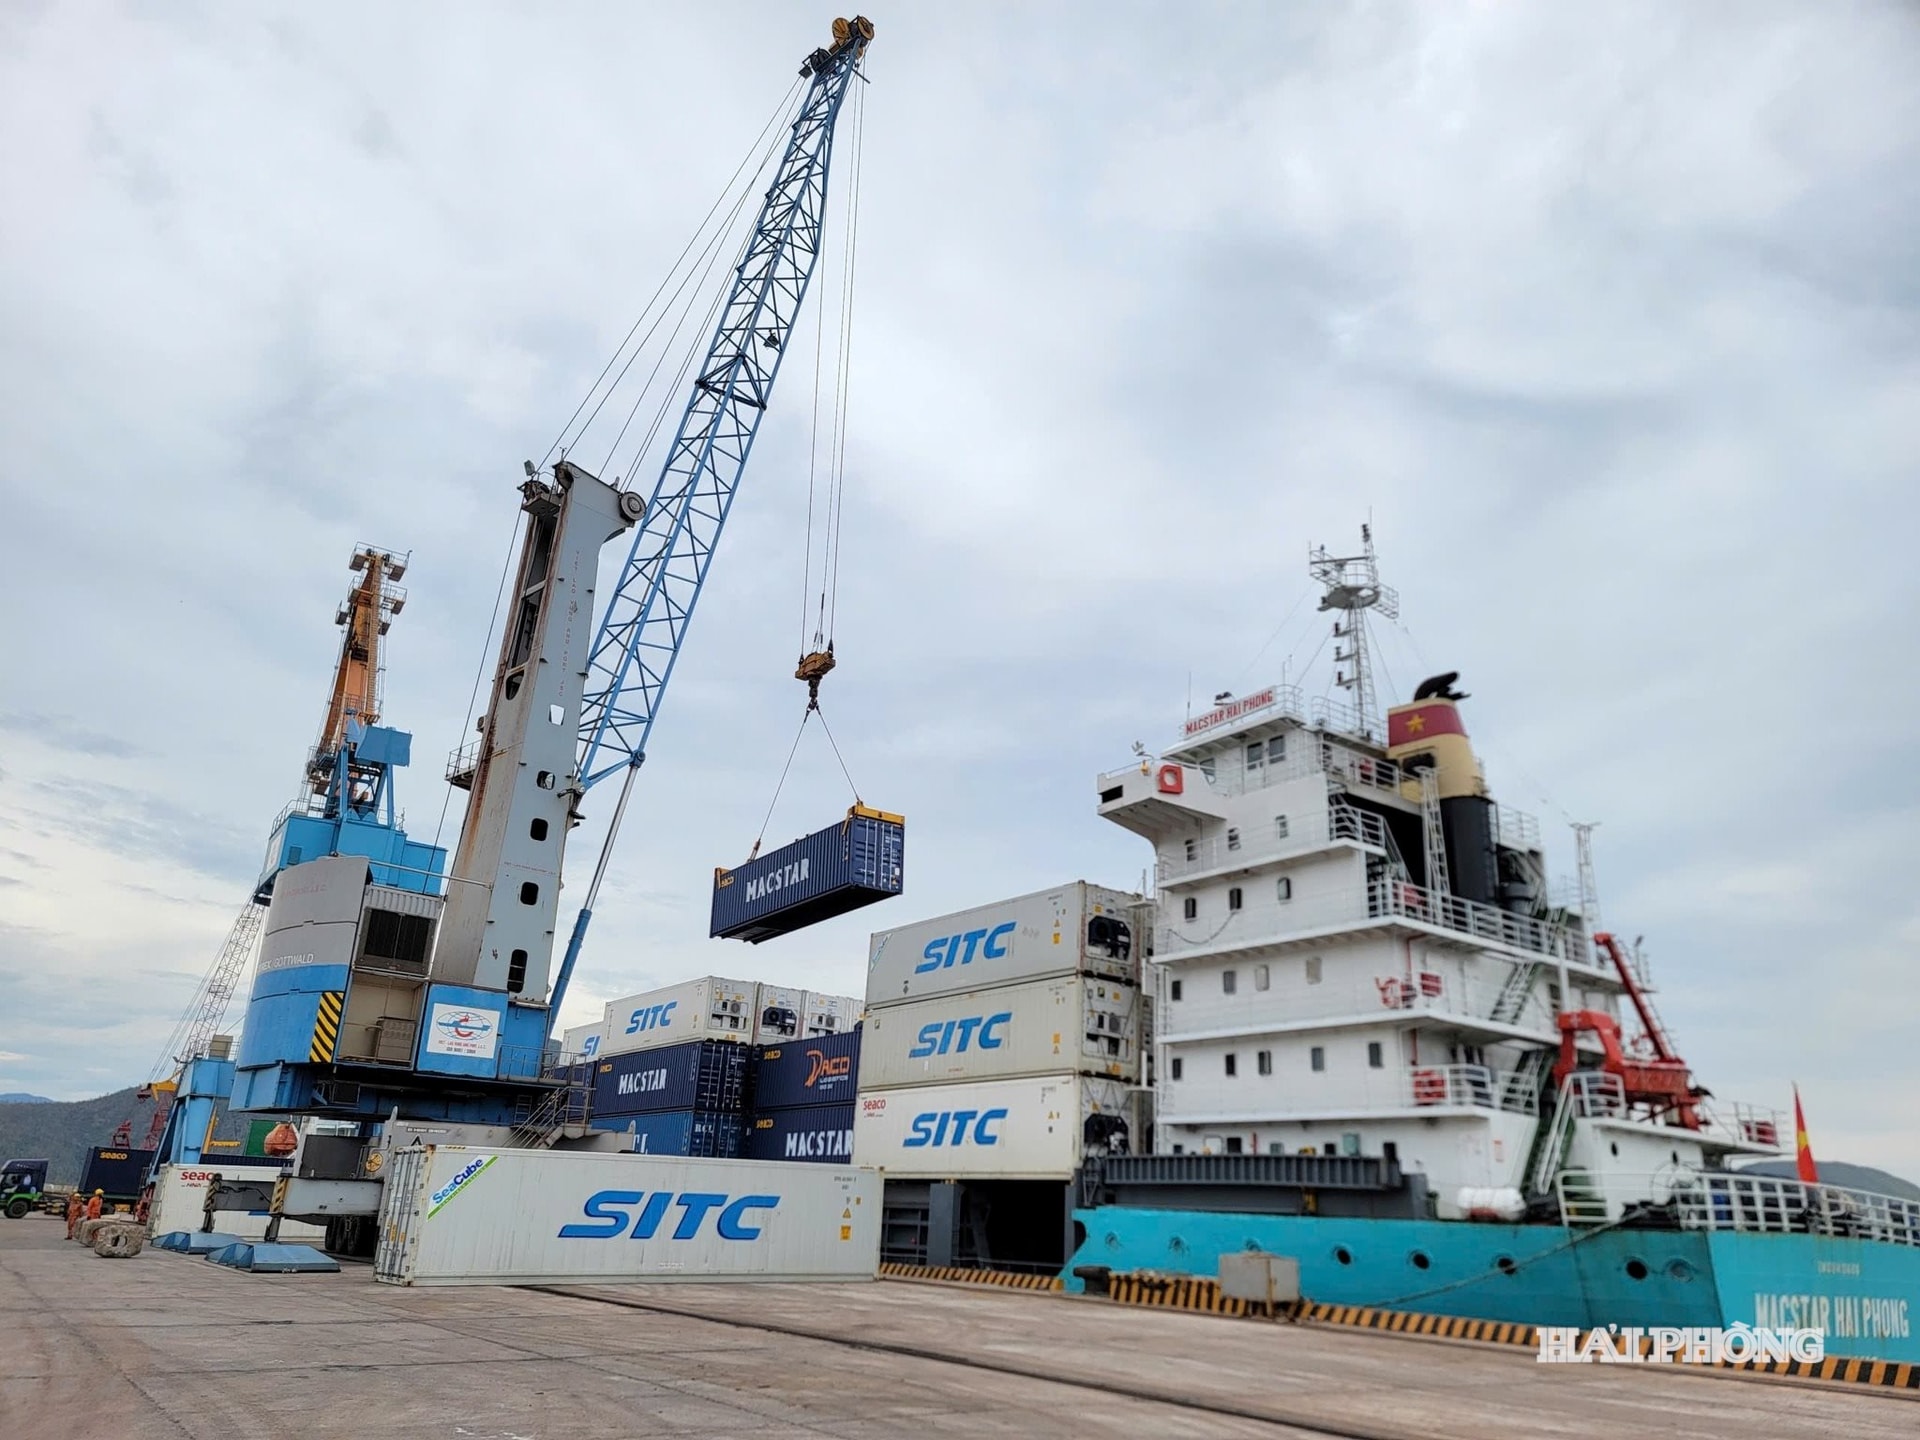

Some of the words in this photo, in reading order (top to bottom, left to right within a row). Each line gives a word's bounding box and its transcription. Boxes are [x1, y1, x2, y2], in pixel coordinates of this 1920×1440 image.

[1186, 709, 1225, 735] MACSTAR
[1226, 704, 1242, 718] HAI
[1243, 690, 1273, 712] PHONG
[745, 857, 810, 903] MACSTAR
[274, 953, 314, 968] GOTTWALD
[915, 920, 1017, 974] SITC
[624, 1001, 678, 1035] SITC
[908, 1012, 1013, 1058] SITC
[583, 1035, 600, 1056] SI
[618, 1068, 667, 1095] MACSTAR
[863, 1099, 887, 1111] seaco
[903, 1108, 1008, 1148] SITC
[100, 1152, 128, 1160] seaco
[180, 1171, 215, 1181] seac
[432, 1159, 484, 1204] SeaCube
[558, 1190, 780, 1241] SITC
[1834, 1296, 1859, 1338] HAI
[1862, 1298, 1909, 1338] PHONG
